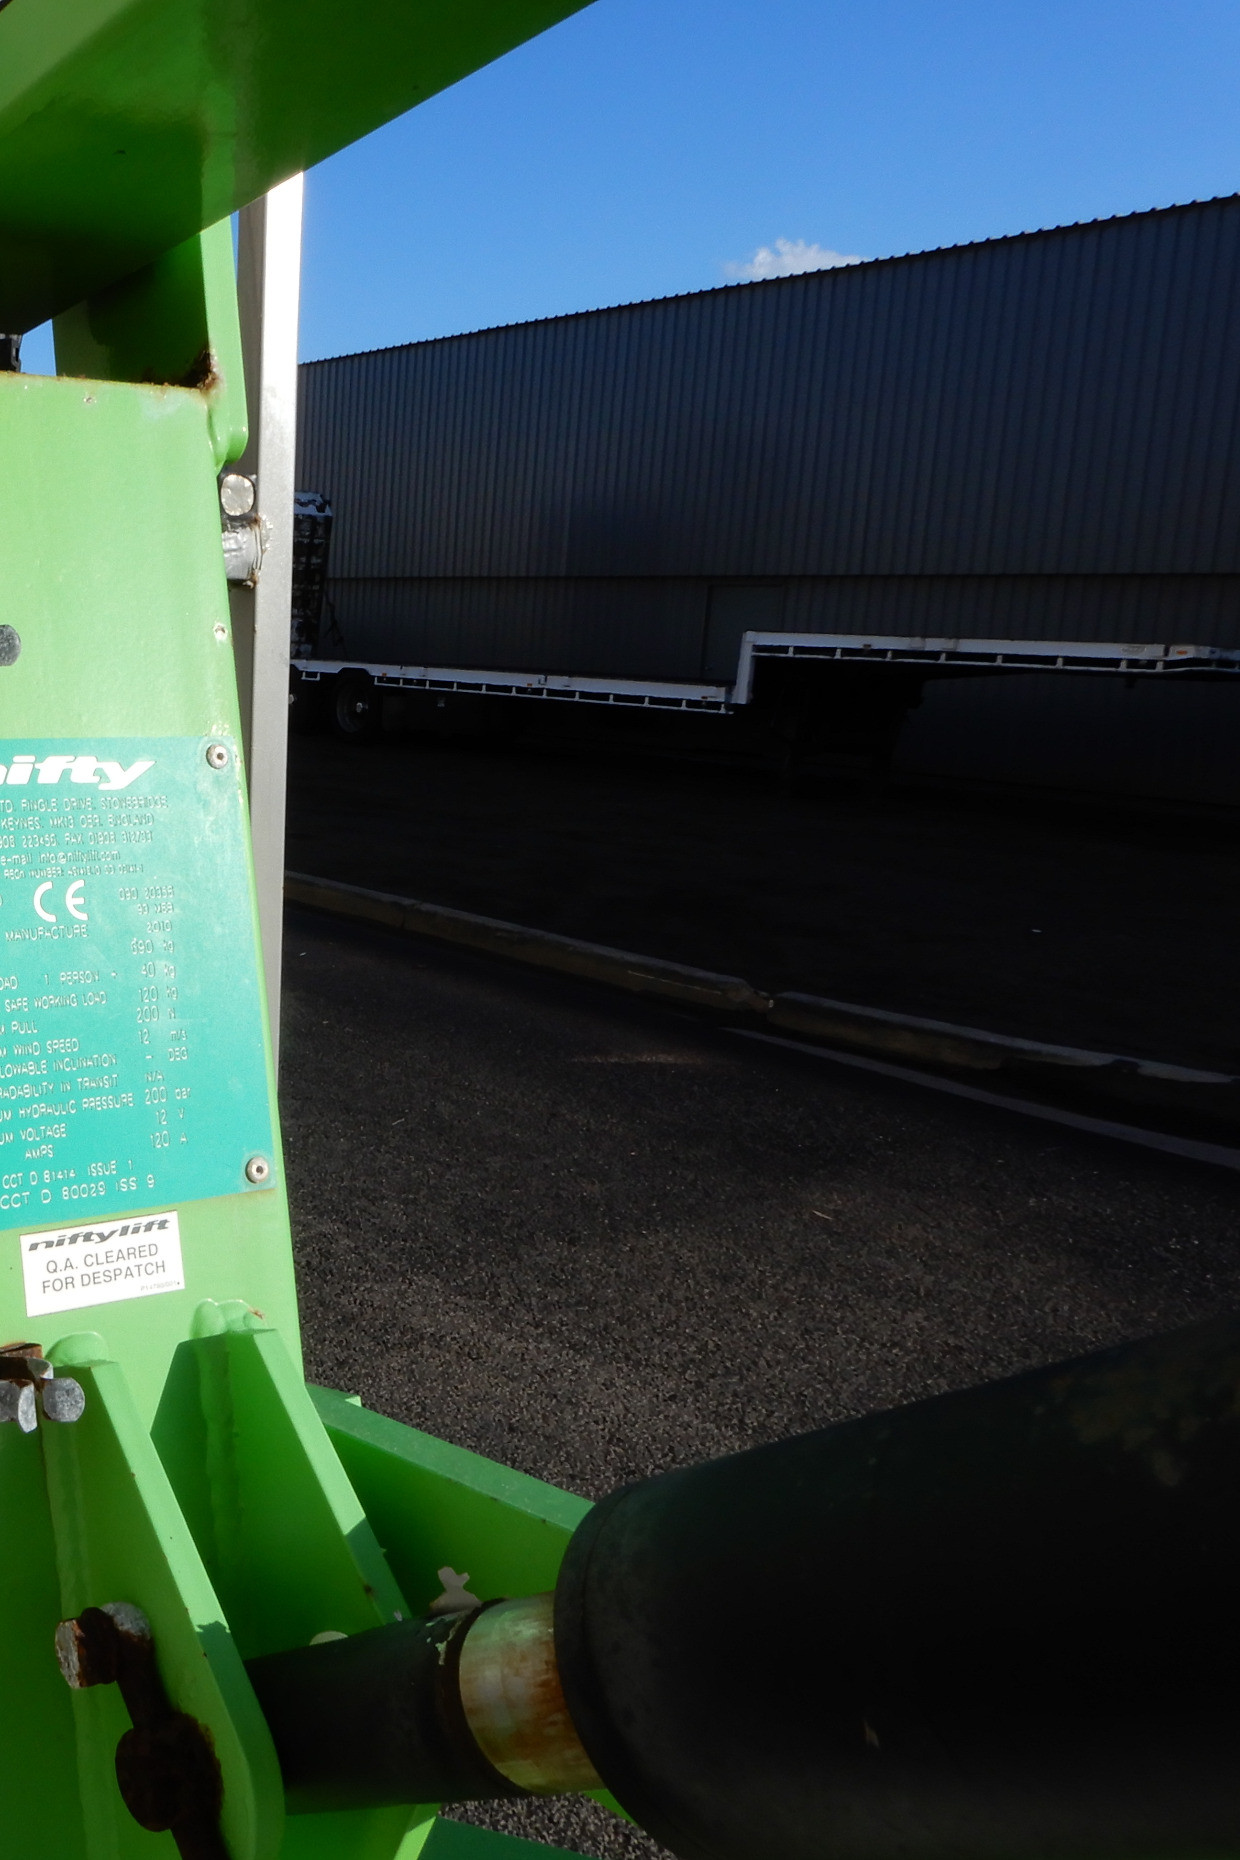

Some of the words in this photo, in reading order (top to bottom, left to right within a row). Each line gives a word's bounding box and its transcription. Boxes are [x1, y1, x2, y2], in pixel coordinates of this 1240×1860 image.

[33, 879, 89, 923] CE
[5, 923, 89, 942] MANUFACTURE
[146, 919, 172, 933] 2010
[60, 970, 100, 985] PERSON
[4, 997, 29, 1013] SAFE
[34, 993, 78, 1010] WORKING
[81, 991, 108, 1006] LOAD
[138, 985, 159, 1002] 120
[11, 1020, 38, 1034] PULL
[136, 1005, 159, 1023] 200
[12, 1041, 41, 1056] WIND
[46, 1037, 80, 1054] SPEED
[138, 1028, 150, 1045] 12
[53, 1053, 117, 1071] INCLINATION
[167, 1046, 188, 1062] DEG
[61, 1080, 71, 1093] IN
[76, 1074, 118, 1091] TRANSIT
[18, 1100, 77, 1118] HYDRAULIC
[82, 1092, 134, 1111] PRESSURE
[144, 1086, 167, 1105] 200
[20, 1123, 67, 1142] VOLTAGE
[156, 1108, 168, 1125] 12
[25, 1144, 54, 1160] AMPS
[150, 1130, 170, 1148] 120
[2, 1172, 23, 1189] CCT
[29, 1171, 38, 1185] D
[43, 1168, 76, 1183] 81414
[87, 1160, 117, 1177] ISSUE
[41, 1189, 52, 1204] D
[62, 1182, 106, 1200] 80029
[115, 1177, 138, 1192] ISS
[146, 1174, 155, 1189] 9
[28, 1218, 171, 1252] niftylift
[46, 1257, 79, 1274] Q.A.
[83, 1243, 159, 1268] CLEARED
[42, 1276, 75, 1294] FOR
[81, 1260, 166, 1287] DESPATCH
